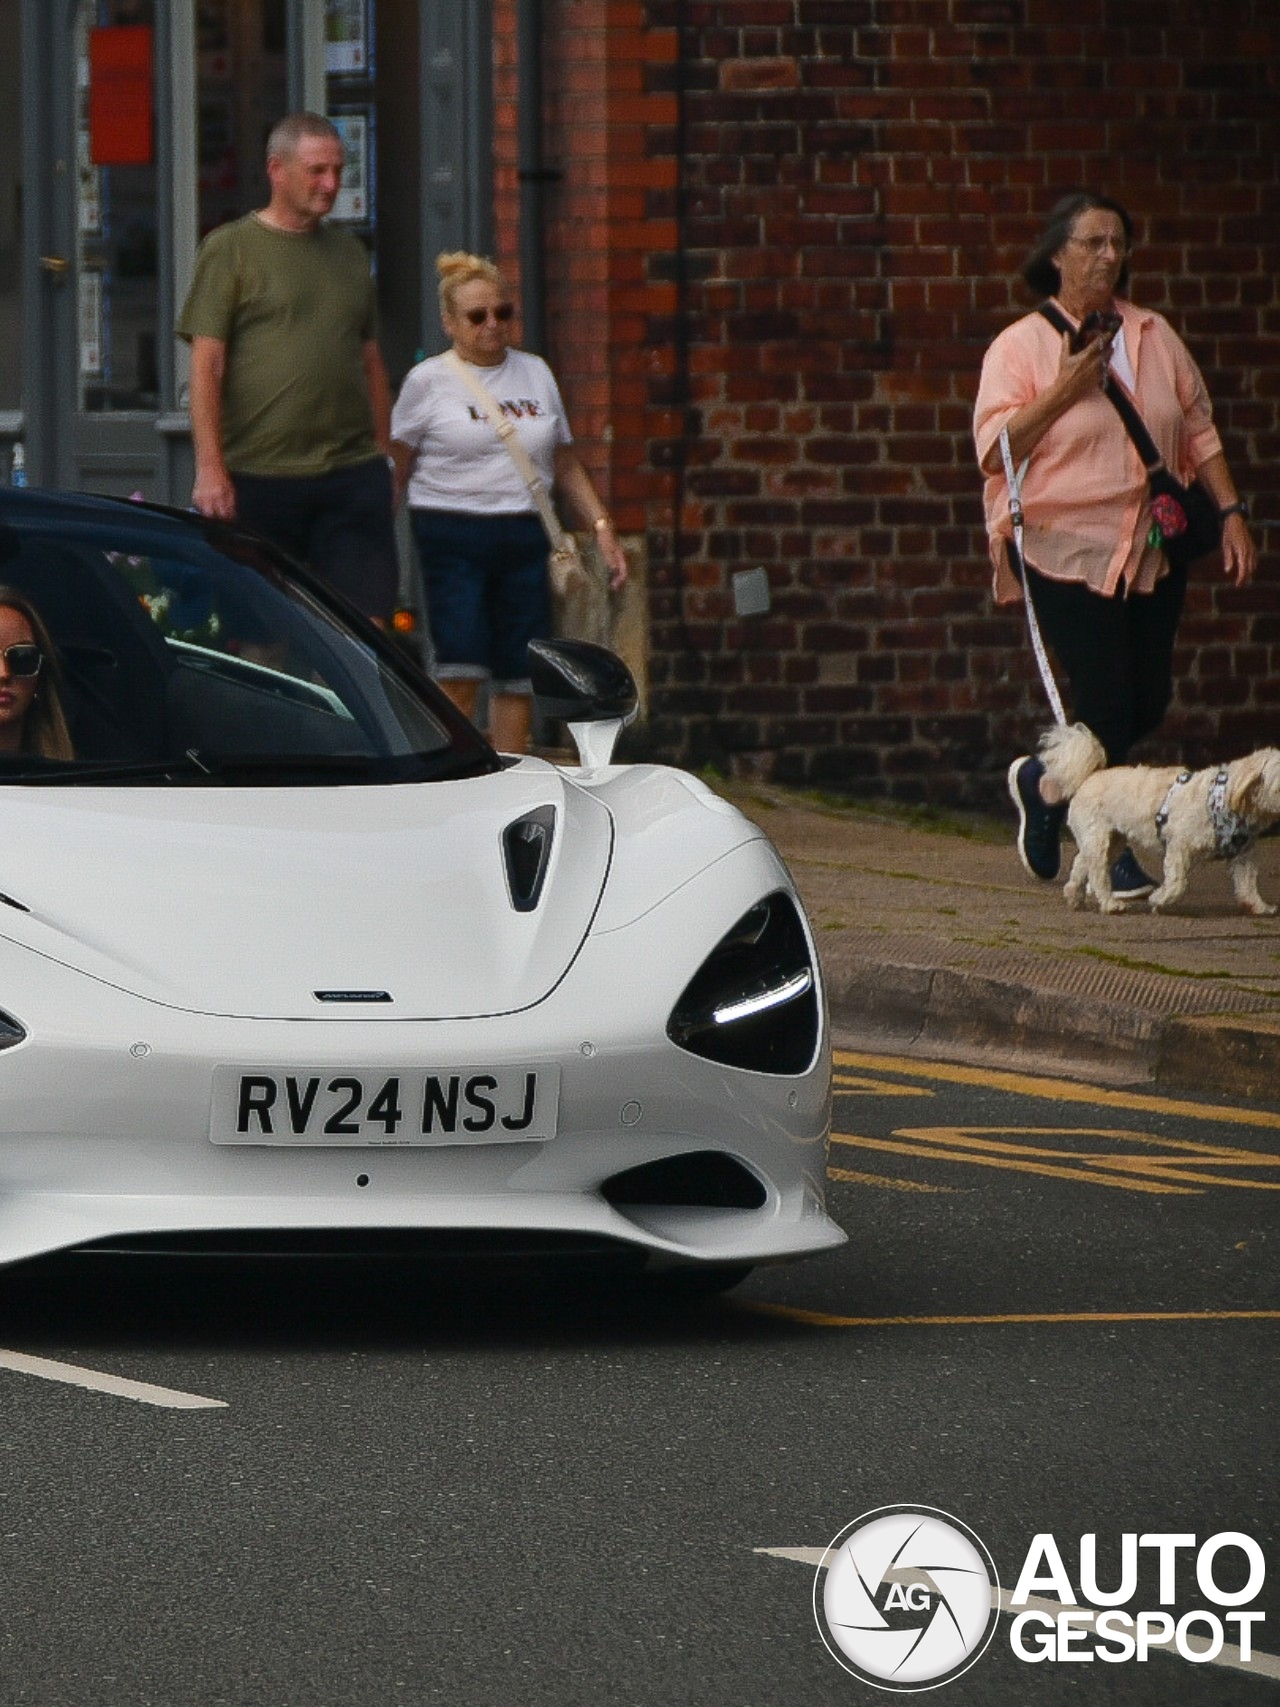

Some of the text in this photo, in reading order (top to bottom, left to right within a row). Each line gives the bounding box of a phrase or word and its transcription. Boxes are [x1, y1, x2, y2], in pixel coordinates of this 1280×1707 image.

[467, 398, 546, 421] LVE
[236, 1073, 537, 1134] RV24 NSJ
